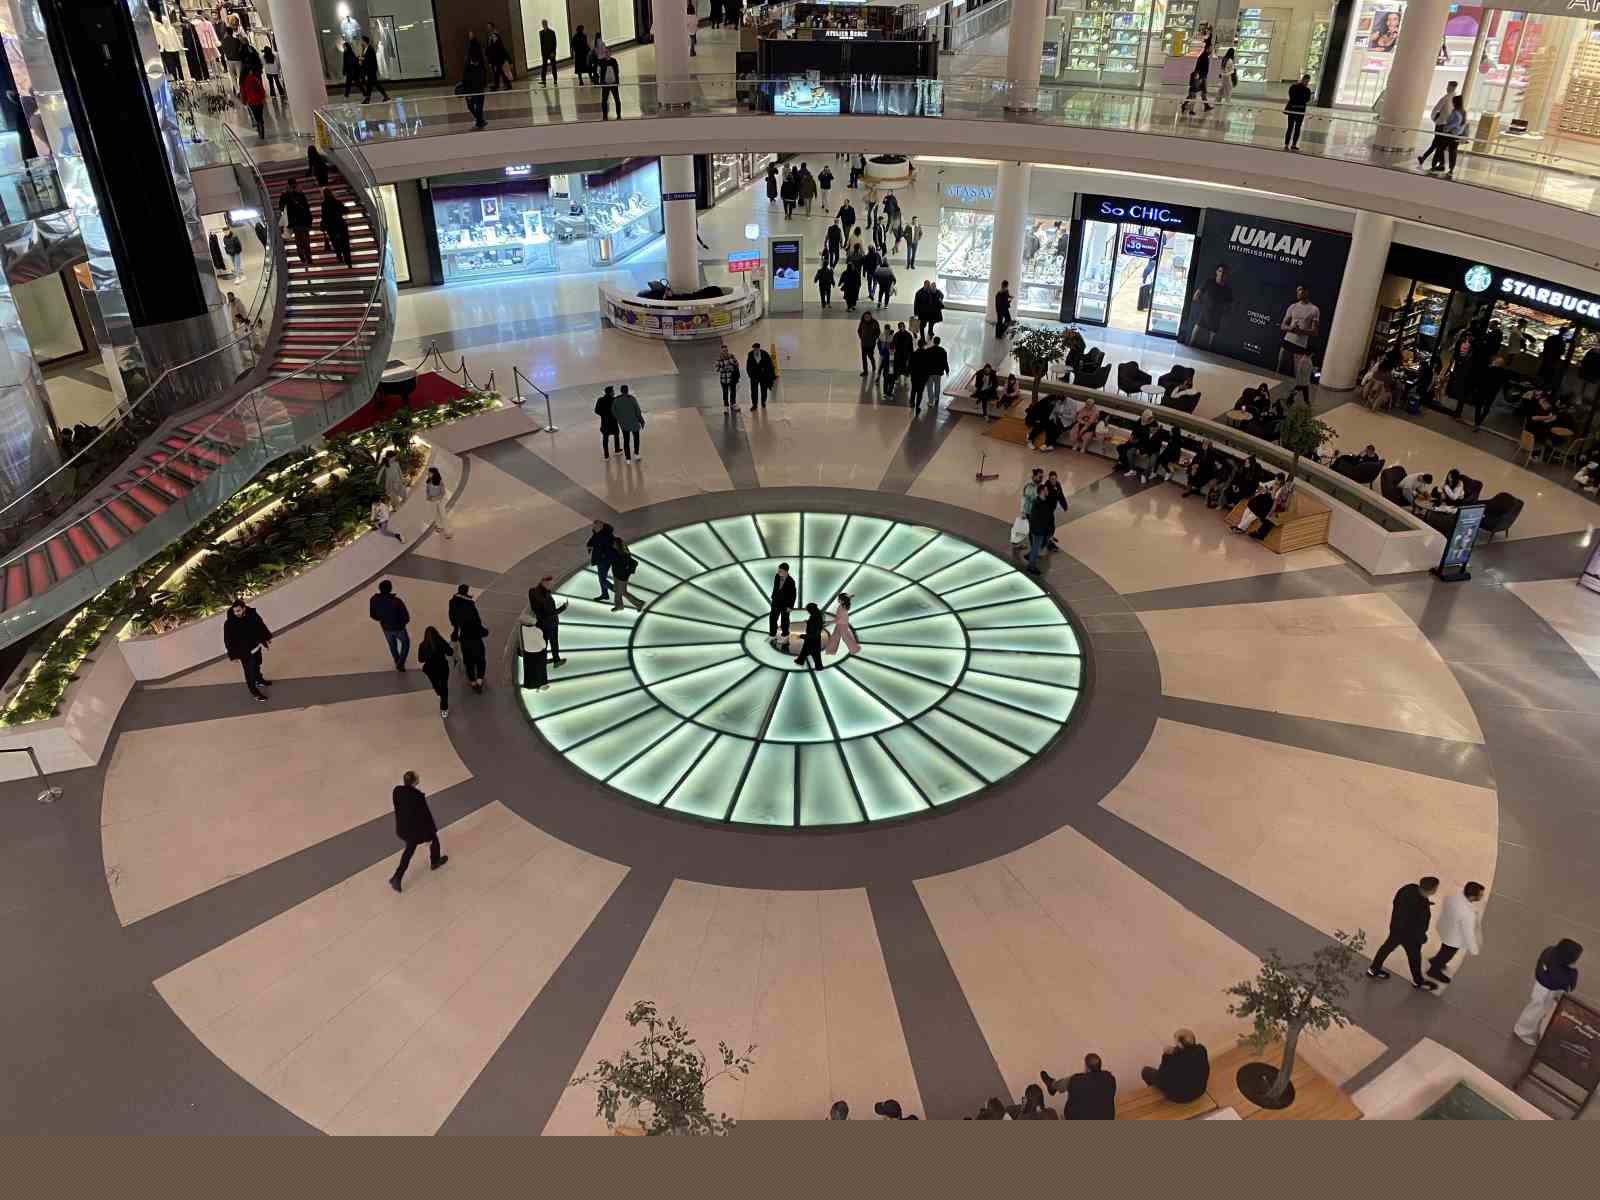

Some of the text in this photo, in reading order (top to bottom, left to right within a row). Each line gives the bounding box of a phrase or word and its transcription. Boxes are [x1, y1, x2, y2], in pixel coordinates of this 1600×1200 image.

[1101, 202, 1124, 216] So
[1230, 225, 1312, 258] IUMAN
[1228, 243, 1303, 266] intimissimi uomo
